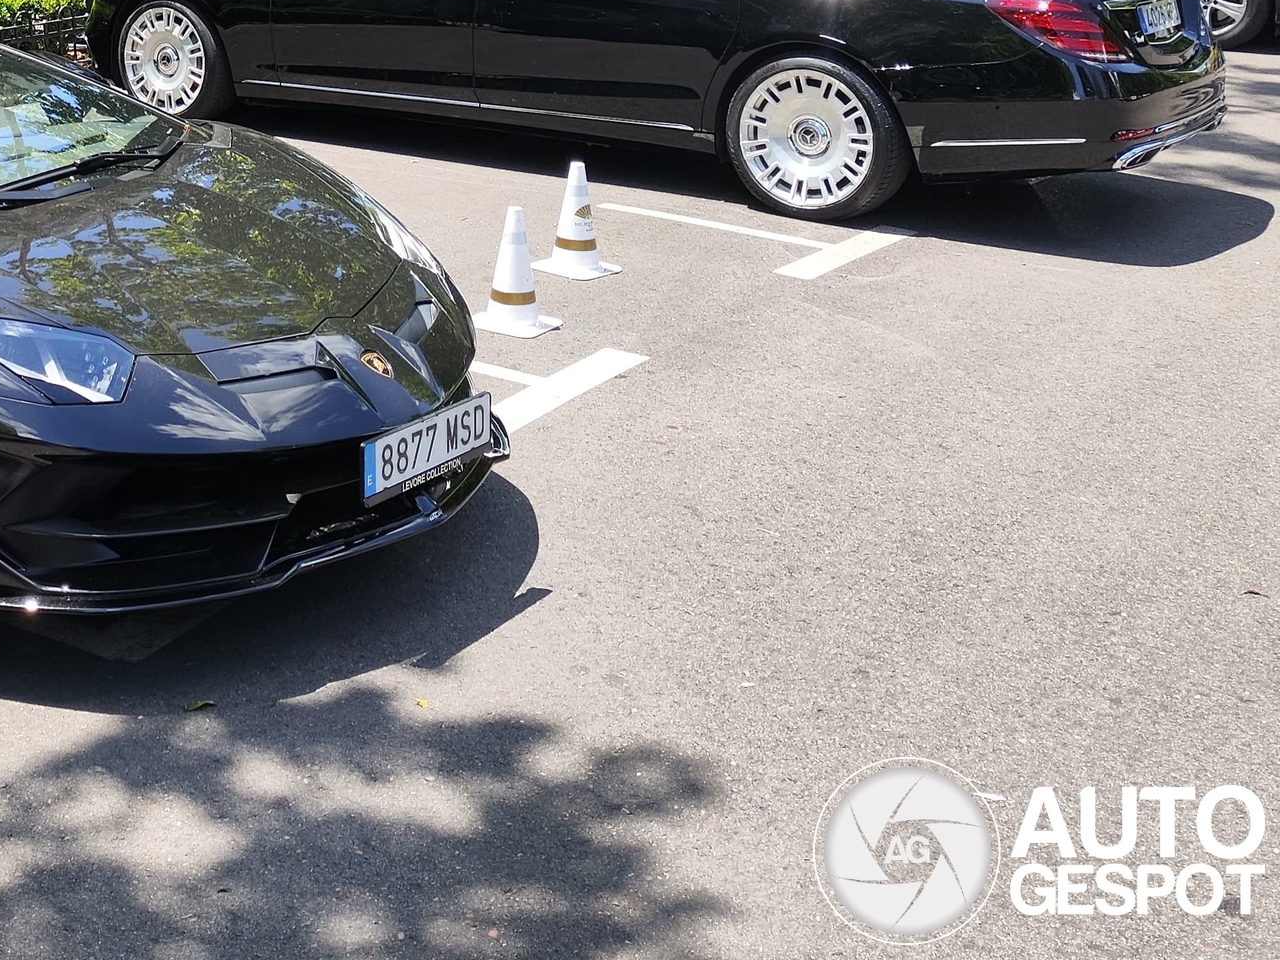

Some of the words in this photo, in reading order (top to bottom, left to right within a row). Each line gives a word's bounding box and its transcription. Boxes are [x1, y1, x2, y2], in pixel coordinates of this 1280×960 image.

[367, 474, 373, 487] E
[381, 423, 438, 481] 8877
[446, 404, 485, 454] MSD
[402, 472, 426, 492] LEVORE
[426, 457, 462, 480] COLLECTION
